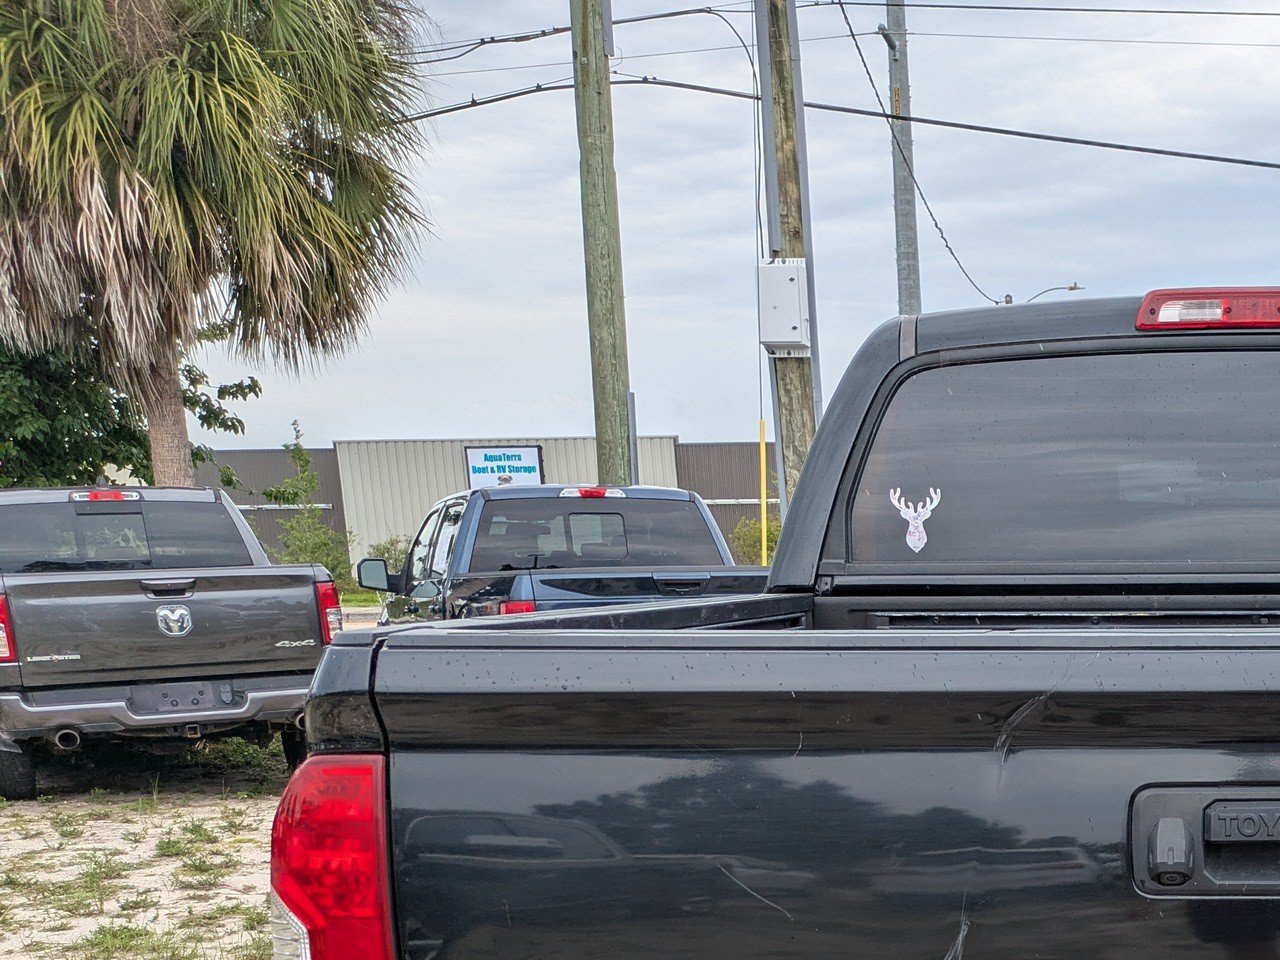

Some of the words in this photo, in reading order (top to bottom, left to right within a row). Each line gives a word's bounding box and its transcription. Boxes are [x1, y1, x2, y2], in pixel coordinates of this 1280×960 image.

[484, 453, 522, 462] AquaTerra
[472, 465, 489, 474] Boat
[496, 465, 507, 474] RV
[507, 464, 537, 474] Storage
